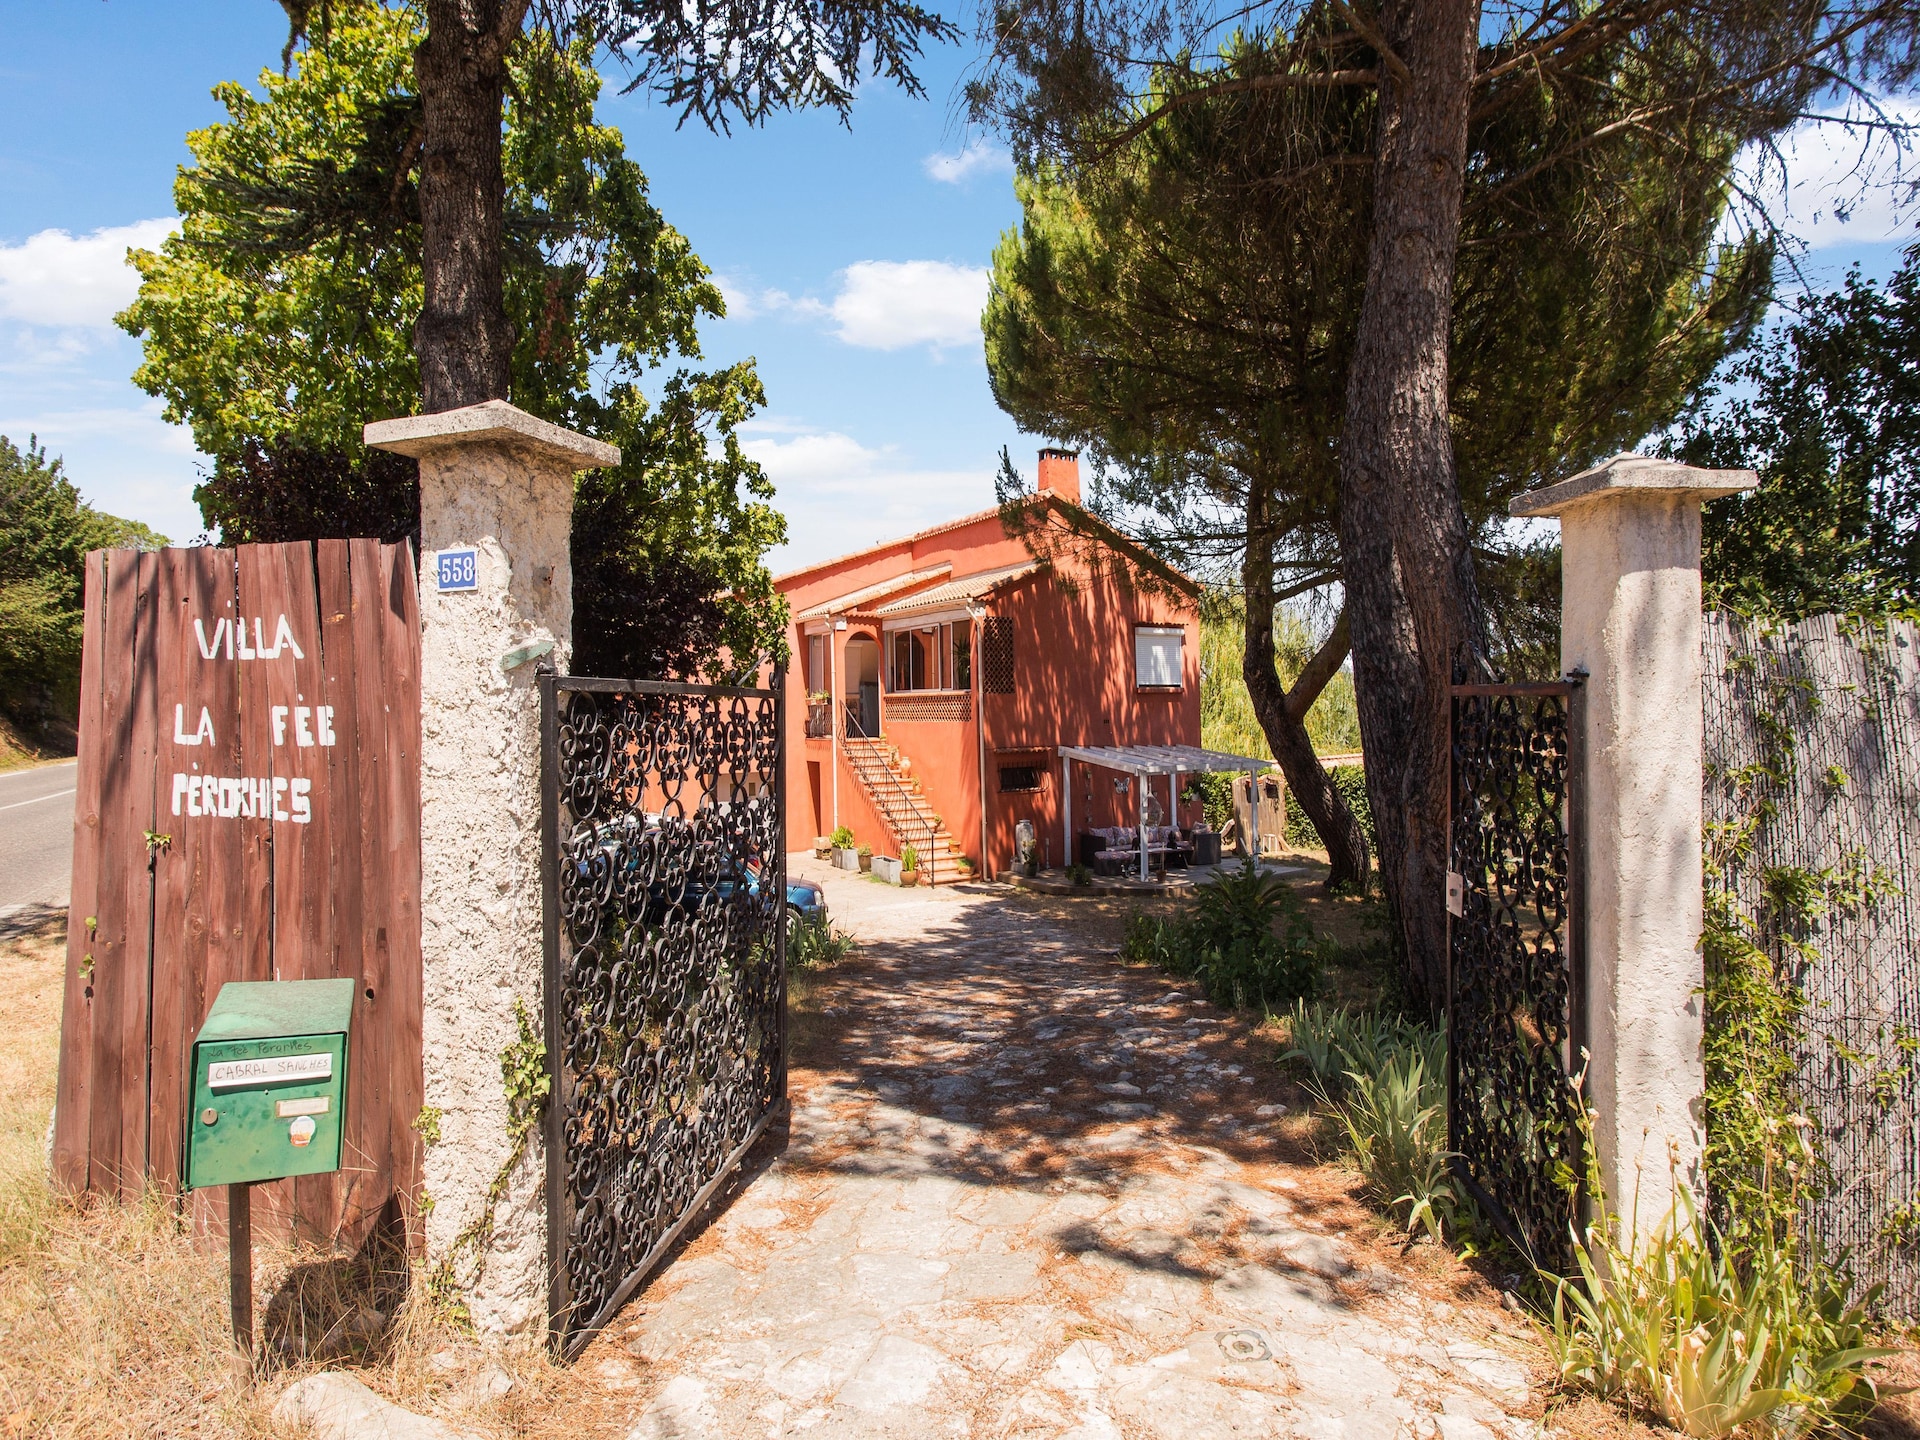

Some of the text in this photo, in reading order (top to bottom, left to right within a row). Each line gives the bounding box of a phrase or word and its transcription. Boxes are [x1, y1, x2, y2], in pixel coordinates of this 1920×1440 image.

[442, 557, 473, 583] 558
[194, 613, 304, 660] VILLA
[174, 704, 215, 746] LA
[215, 1063, 268, 1080] CABRAL
